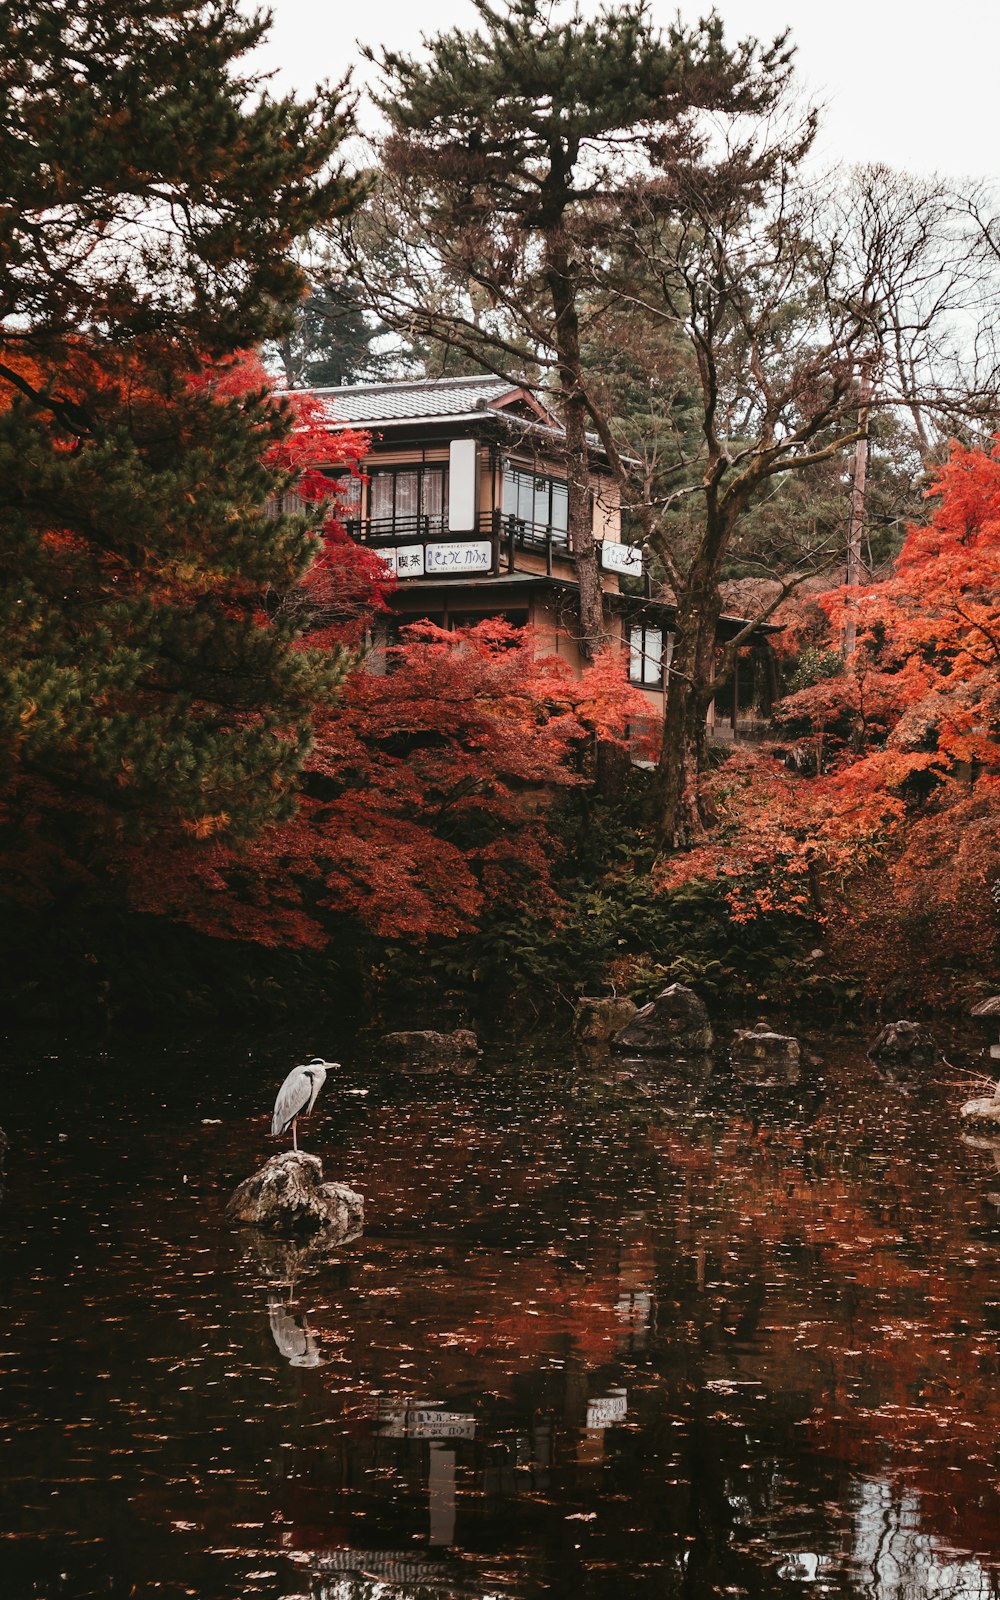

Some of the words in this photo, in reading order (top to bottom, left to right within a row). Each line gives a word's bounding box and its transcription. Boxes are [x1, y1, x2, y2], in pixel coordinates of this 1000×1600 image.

[398, 554, 421, 568] 喫茶
[435, 551, 462, 565] きょうと
